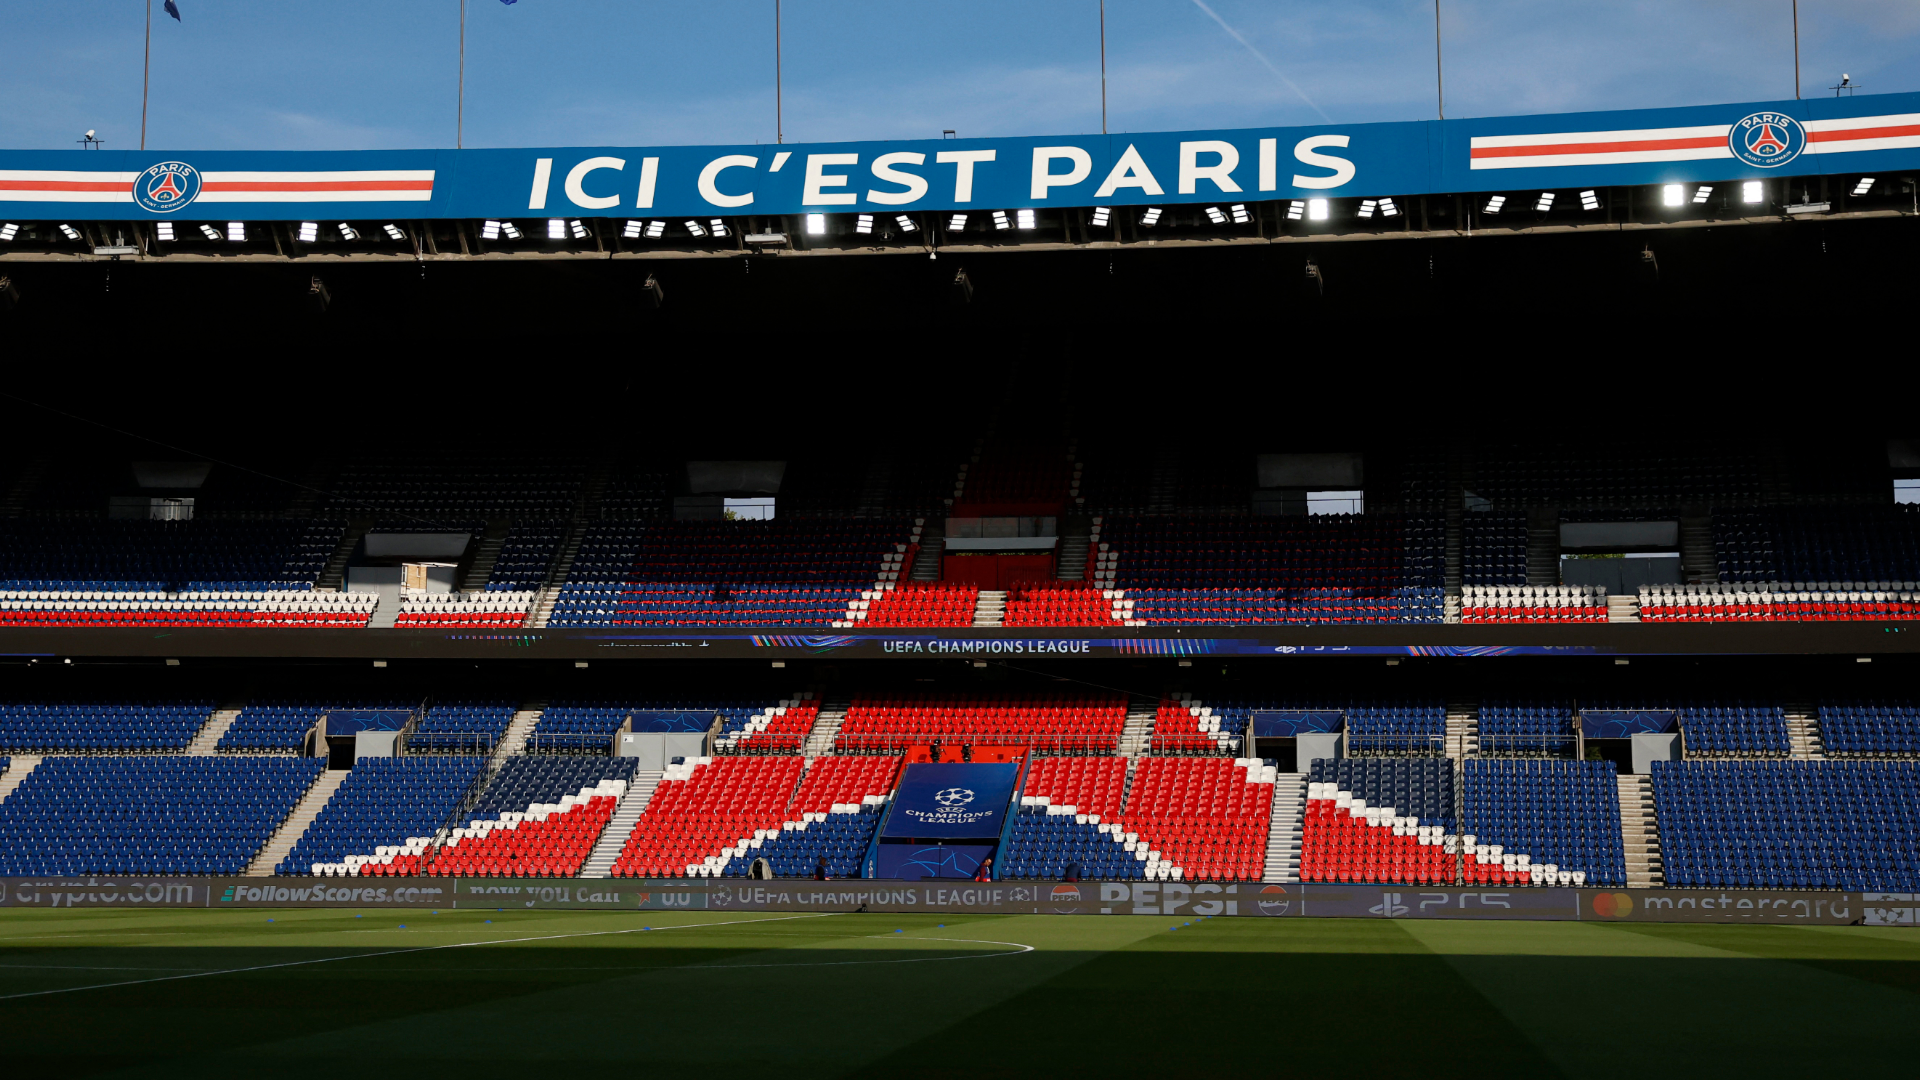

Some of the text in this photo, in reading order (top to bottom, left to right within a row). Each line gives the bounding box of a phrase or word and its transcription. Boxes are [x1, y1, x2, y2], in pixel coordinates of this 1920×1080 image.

[1741, 114, 1790, 129] PARIS
[1743, 150, 1792, 163] SAINT GERMAIN
[149, 163, 192, 177] PARIS
[528, 134, 1356, 210] ICI C'EST PARIS
[143, 197, 186, 209] SAINT GERMAIN
[883, 640, 1090, 653] UEFA CHAMPIONS LEAGUE
[905, 809, 993, 819] CHAMPIONS
[919, 816, 977, 824] LEAGUE
[16, 878, 193, 907] crypto.com
[233, 883, 443, 903] FollowScores.com
[525, 886, 571, 907] you
[738, 887, 1002, 906] UEFA CHAMPIONS LEAGUE
[1052, 894, 1080, 902] PEPSI
[1100, 883, 1238, 916] PEPSI
